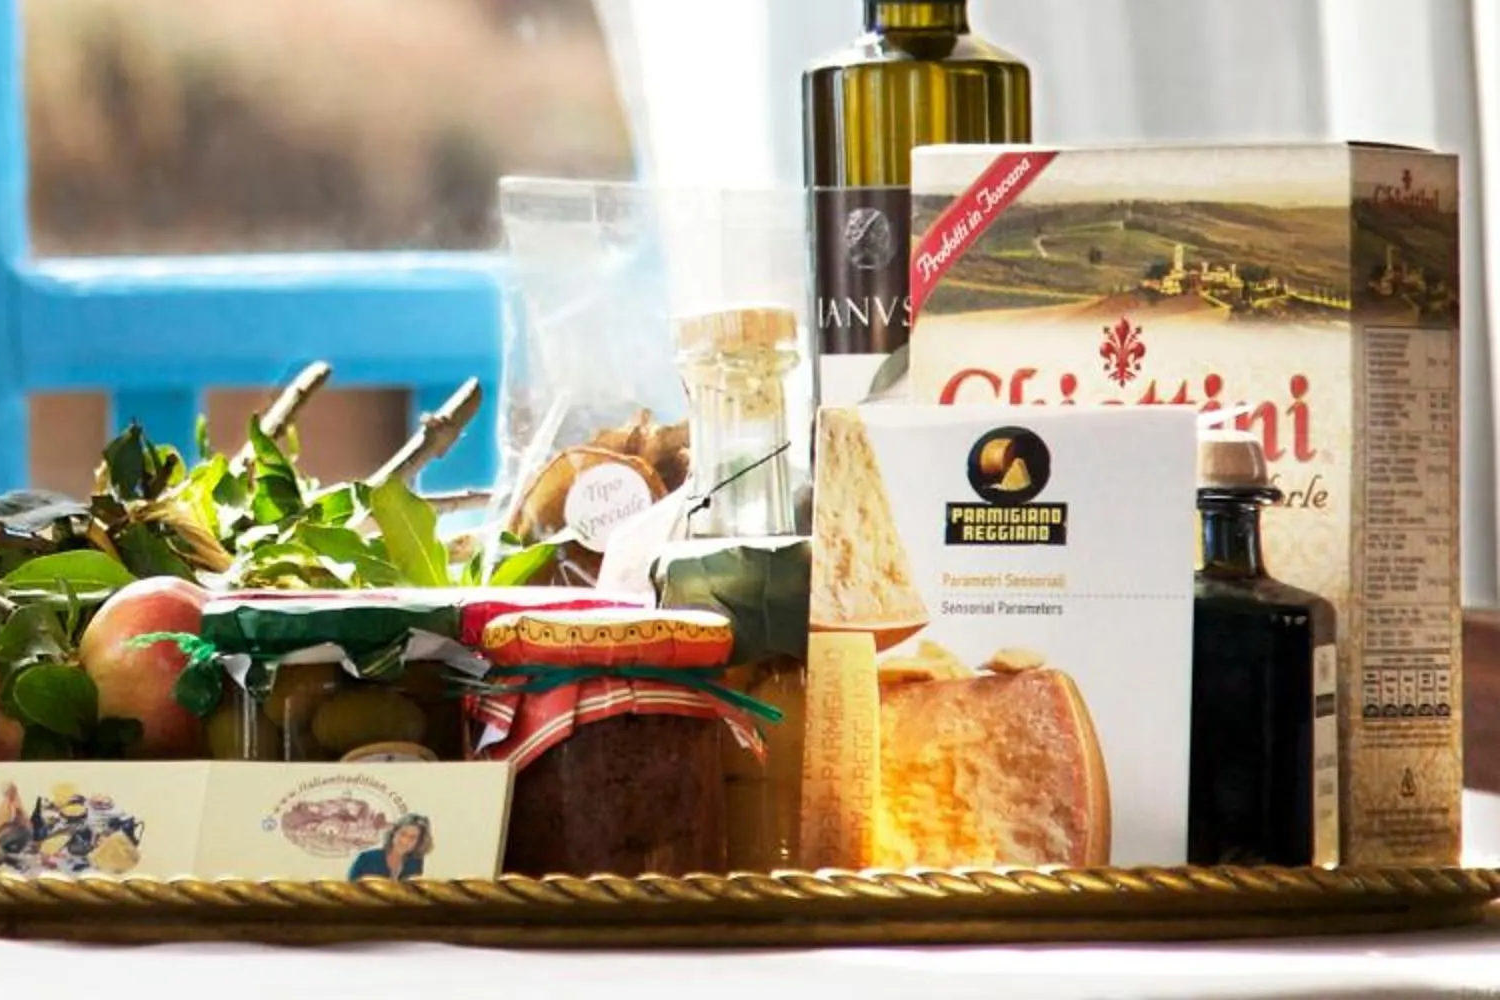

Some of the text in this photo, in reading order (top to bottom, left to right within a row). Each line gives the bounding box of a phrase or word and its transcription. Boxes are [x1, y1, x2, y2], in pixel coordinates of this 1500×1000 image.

[916, 218, 970, 284] Prodotti
[975, 157, 1031, 213] Toscana
[951, 507, 1062, 524] PARMIGIANO
[963, 525, 1050, 541] REGGIANO
[942, 573, 1002, 588] Parametri
[941, 601, 1064, 615] Sensorial Parameters
